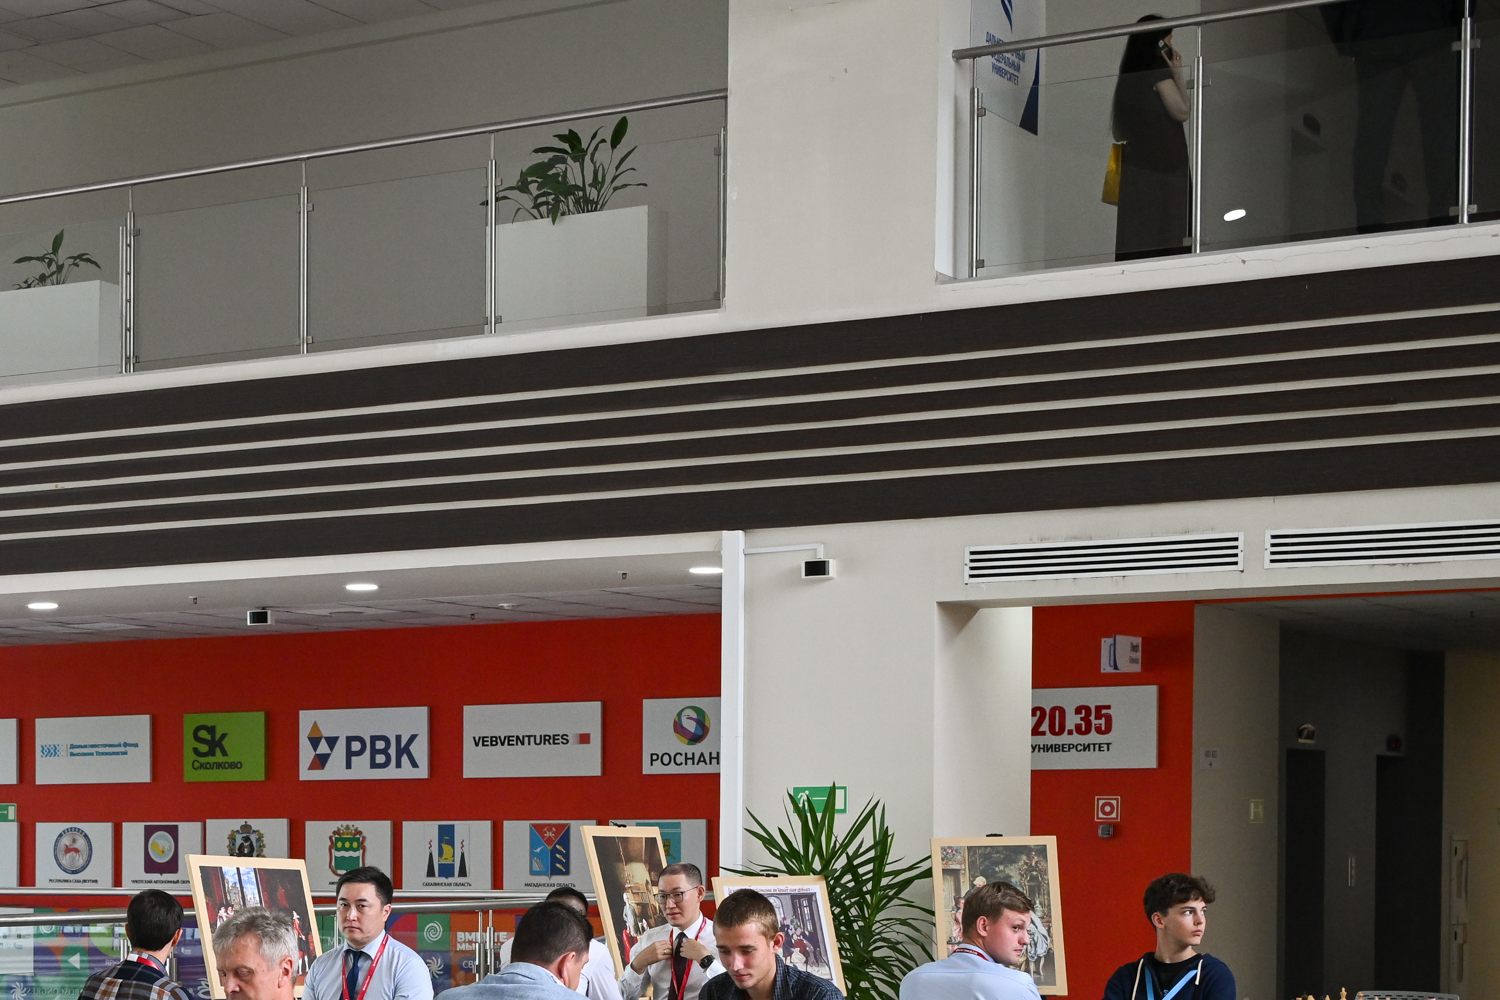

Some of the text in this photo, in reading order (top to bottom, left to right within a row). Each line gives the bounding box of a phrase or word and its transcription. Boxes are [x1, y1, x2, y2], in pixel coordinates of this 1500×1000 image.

[1031, 704, 1113, 737] 20.35
[192, 724, 229, 758] Sk
[345, 733, 420, 770] РВК
[472, 733, 570, 747] VEBVENTURES
[1031, 742, 1113, 753] УНИВЕРСИТЕТ
[649, 751, 720, 767] РОСНАН
